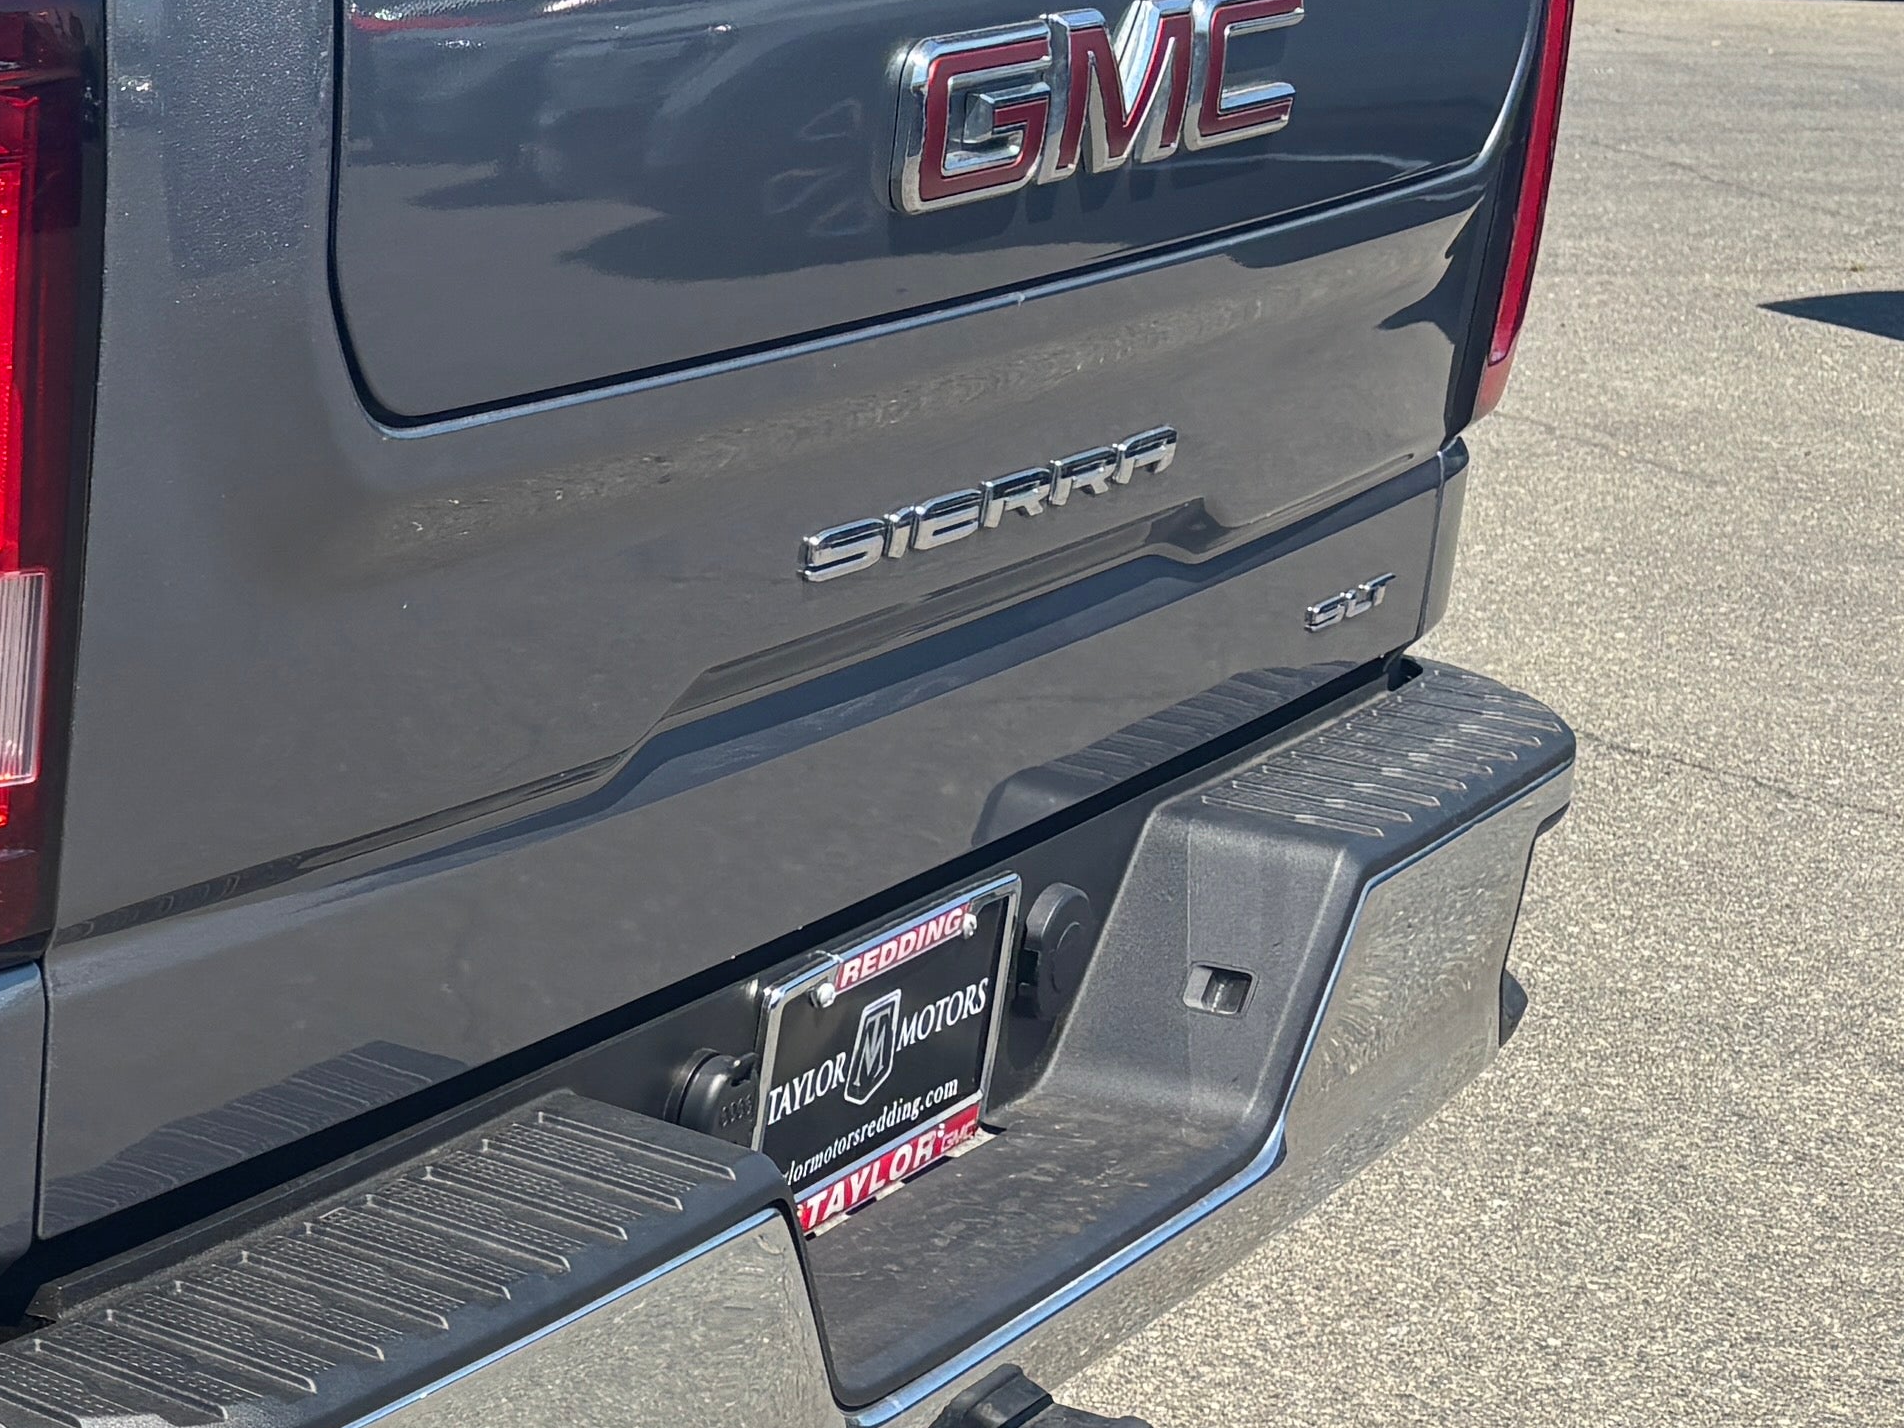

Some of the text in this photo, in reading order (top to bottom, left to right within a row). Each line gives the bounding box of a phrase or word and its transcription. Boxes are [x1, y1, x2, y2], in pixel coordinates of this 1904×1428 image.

[797, 425, 1179, 582] SIERRA
[1304, 573, 1397, 633] SLT
[839, 907, 966, 989] REDDING
[767, 1051, 847, 1126] TAYLOR
[895, 977, 989, 1053] MOTORS
[806, 1129, 937, 1229] TAYLOR
[941, 1122, 976, 1153] GMC
